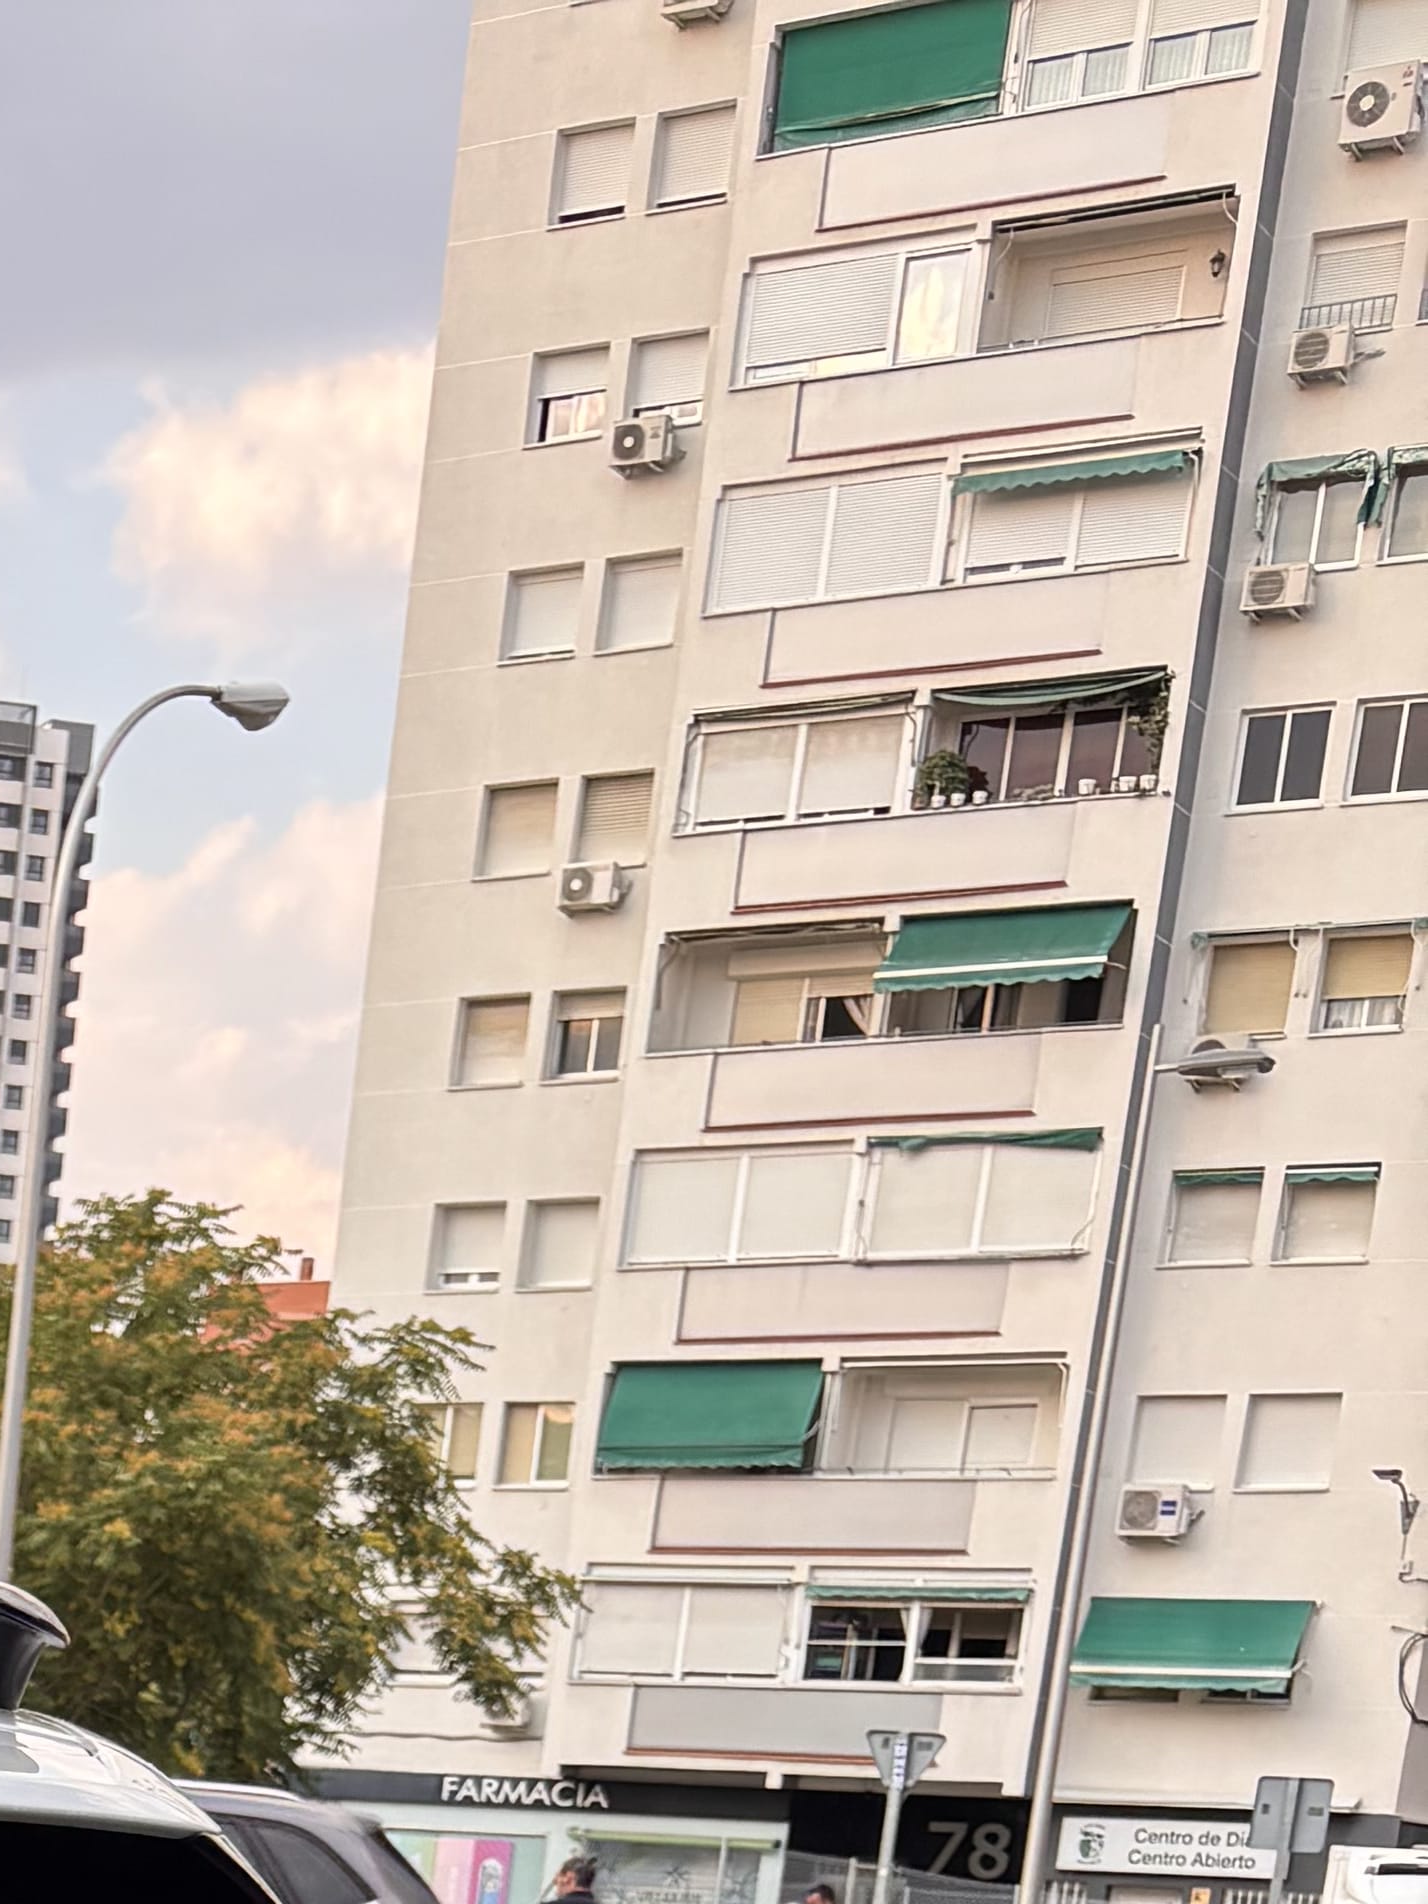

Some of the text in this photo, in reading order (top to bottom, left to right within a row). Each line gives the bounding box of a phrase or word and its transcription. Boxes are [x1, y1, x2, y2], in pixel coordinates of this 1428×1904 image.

[441, 1776, 609, 1808] FARMACIA
[927, 1821, 1011, 1880] 78
[1134, 1828, 1193, 1846] Centro
[1198, 1831, 1222, 1847] de
[1128, 1849, 1256, 1870] Centro Abierto
